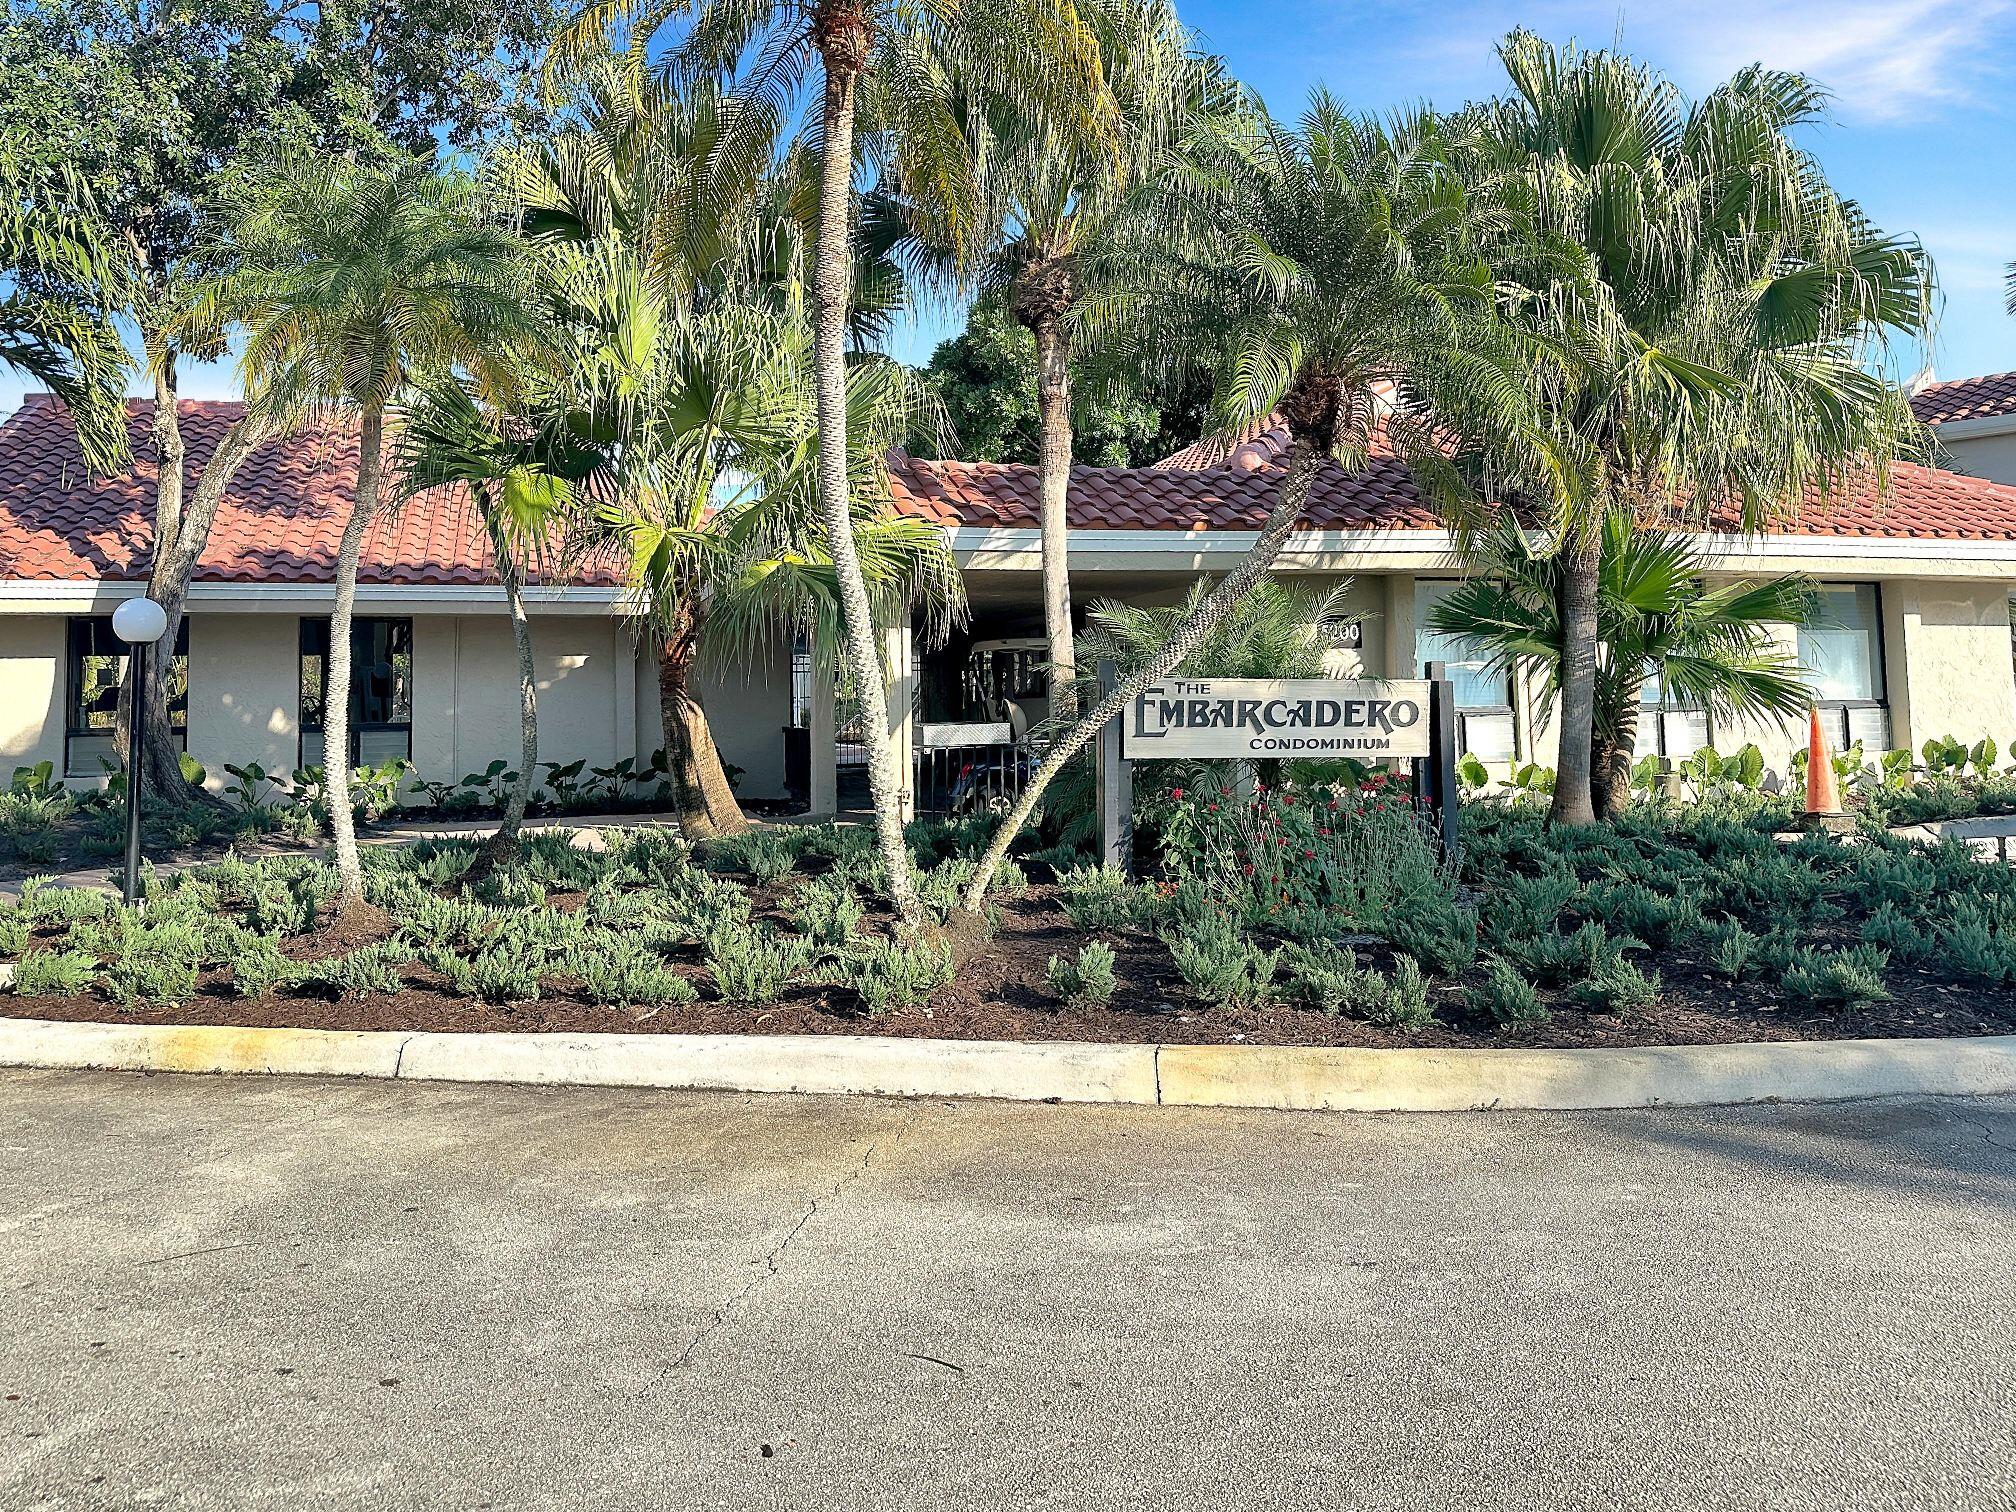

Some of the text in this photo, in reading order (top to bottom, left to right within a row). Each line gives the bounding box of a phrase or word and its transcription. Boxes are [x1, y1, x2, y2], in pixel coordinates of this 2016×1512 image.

[1174, 681, 1211, 695] THE
[1132, 687, 1420, 738] EMBARCADERO
[1249, 738, 1390, 750] CONDOMINIUM
